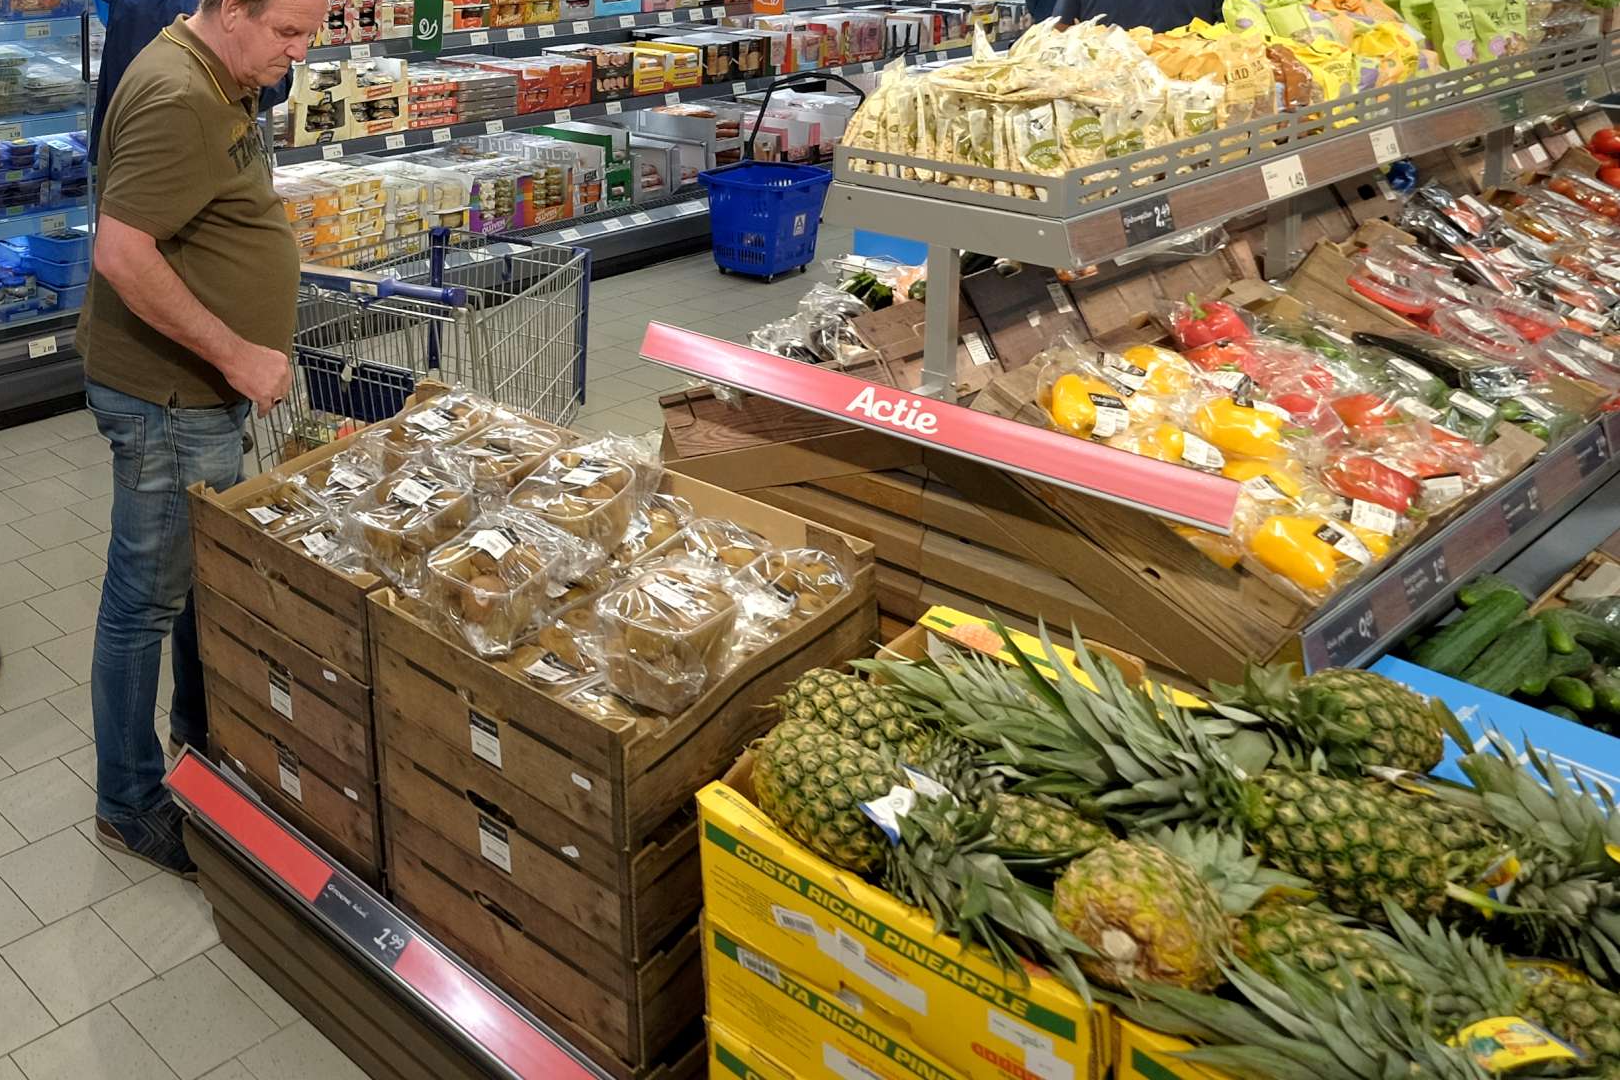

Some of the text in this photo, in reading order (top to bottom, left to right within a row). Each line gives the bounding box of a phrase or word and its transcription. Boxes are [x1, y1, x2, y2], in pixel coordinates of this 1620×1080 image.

[845, 386, 940, 436] Actie
[734, 843, 804, 892] COSTA
[806, 885, 878, 937] RICAN
[882, 929, 1030, 1018] PINEAPPLE
[815, 999, 888, 1052] RICAN
